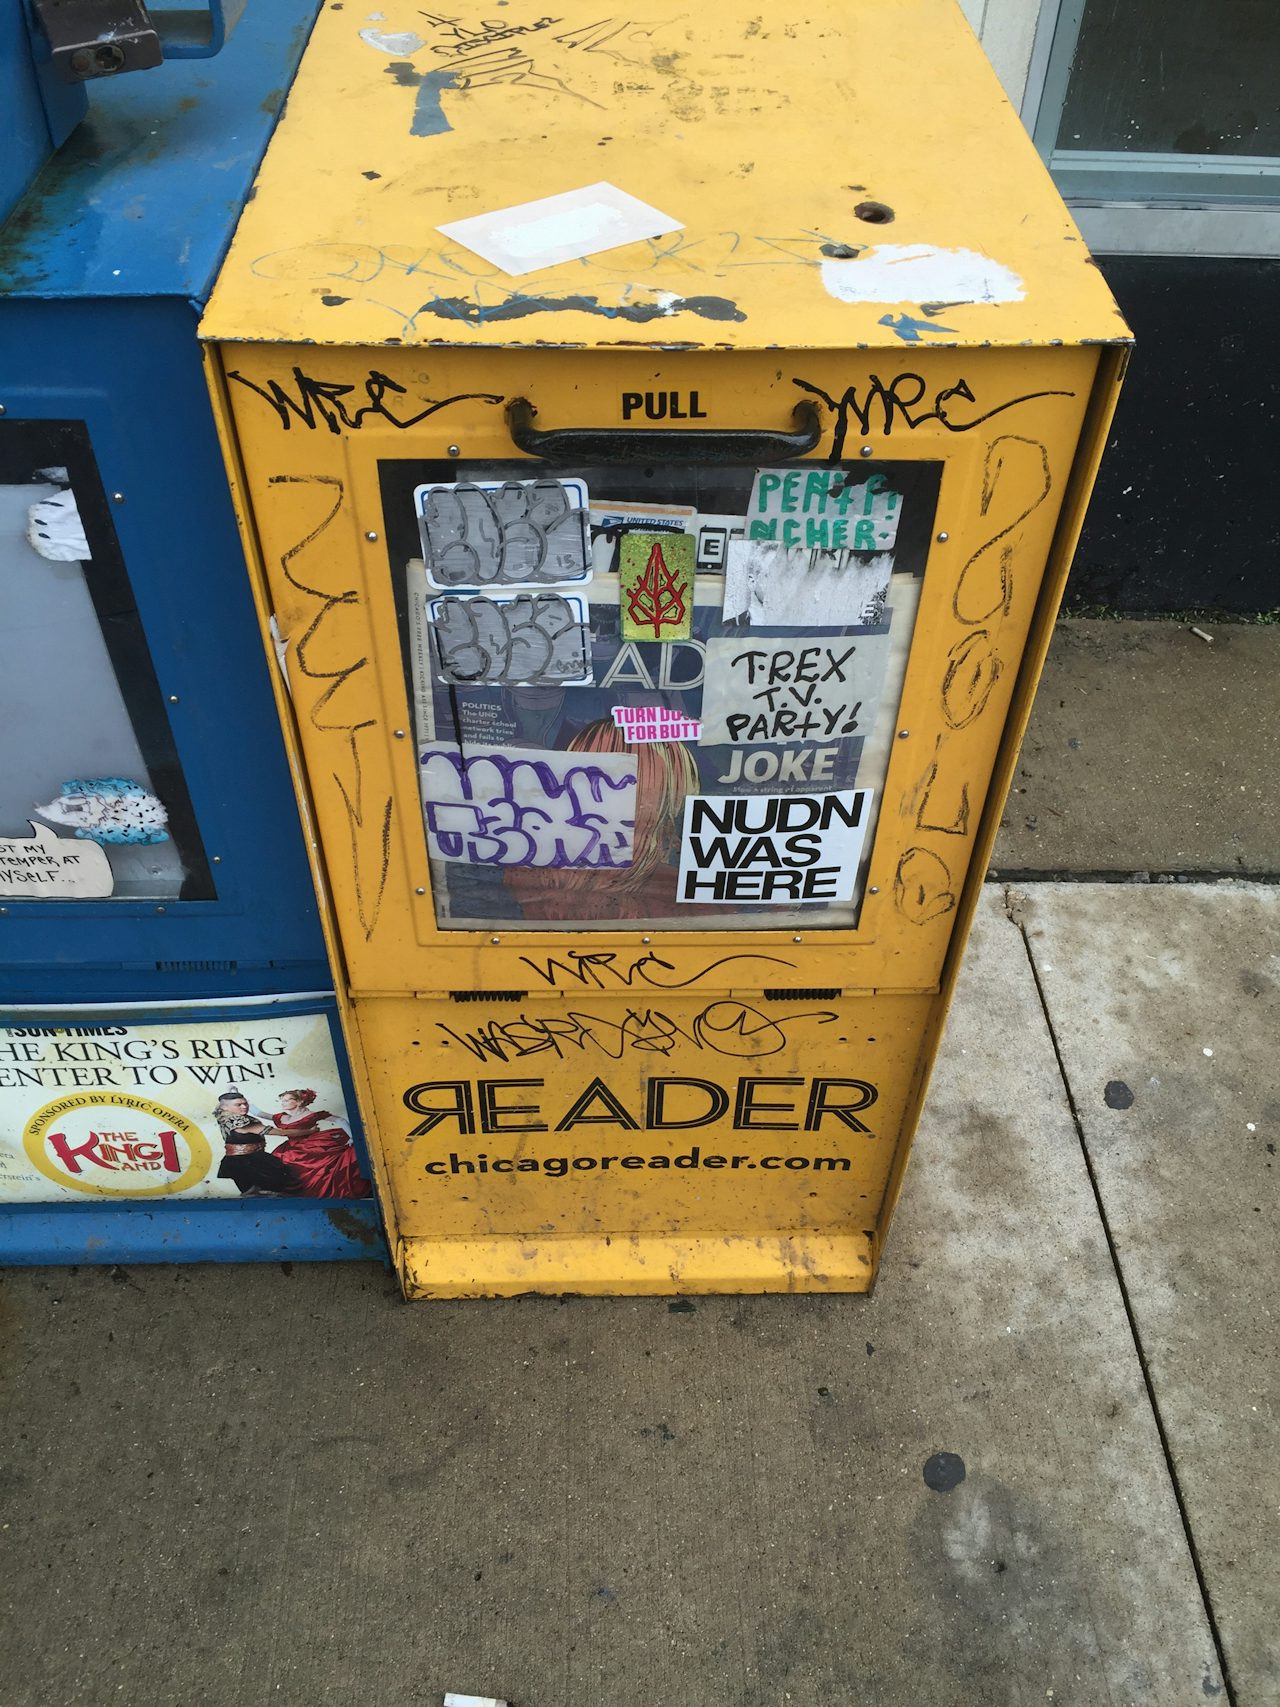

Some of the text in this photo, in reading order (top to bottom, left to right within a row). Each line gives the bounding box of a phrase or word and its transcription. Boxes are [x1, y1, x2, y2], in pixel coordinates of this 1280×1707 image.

[622, 391, 707, 420] PULL
[626, 516, 684, 526] UNITED STATES
[462, 702, 502, 711] POLITICS
[753, 684, 822, 712] T.V.
[492, 720, 516, 728] school
[615, 706, 656, 724] TURN
[726, 702, 862, 741] PARTY!
[479, 733, 495, 741] fails
[628, 722, 700, 740] FOR BUTT
[717, 747, 839, 783] JOKE
[760, 786, 783, 795] string
[690, 792, 864, 834] NUDN
[24, 844, 46, 854] MY
[62, 855, 80, 865] AT
[689, 834, 822, 868] WAS
[684, 866, 841, 900] HERE
[50, 1040, 180, 1062] KING'S
[188, 1037, 286, 1059] RING
[0, 1062, 276, 1088] ENTER TO WIN!
[29, 1094, 190, 1136] SPONSORED BY LYRIC OPERA
[403, 1076, 879, 1137] READER
[47, 1130, 181, 1174] THE KING AND I
[425, 1147, 852, 1177] chicagoreader.com
